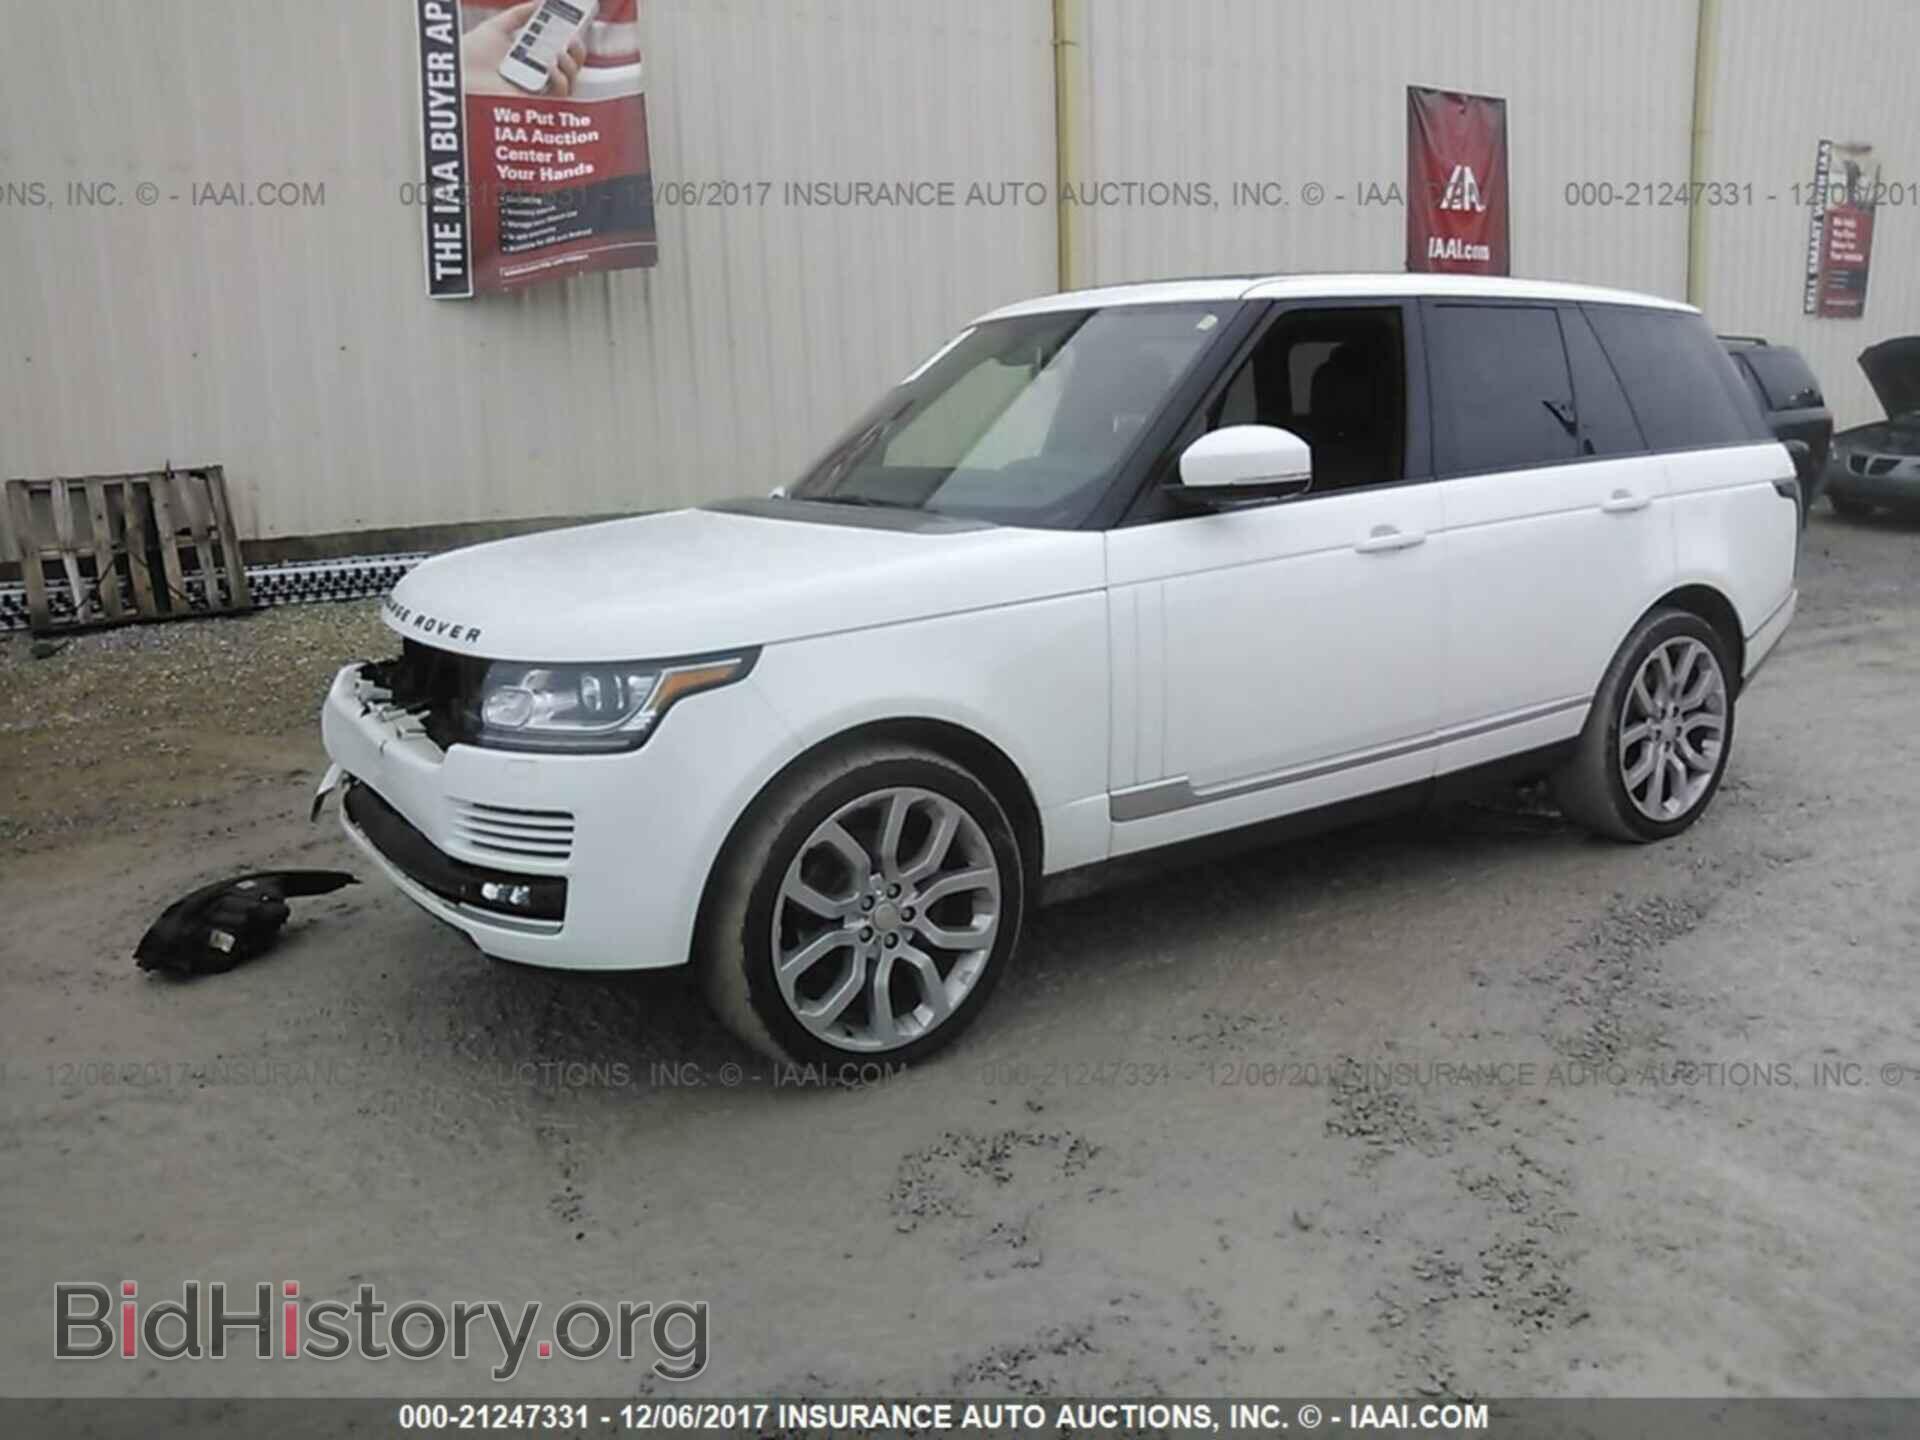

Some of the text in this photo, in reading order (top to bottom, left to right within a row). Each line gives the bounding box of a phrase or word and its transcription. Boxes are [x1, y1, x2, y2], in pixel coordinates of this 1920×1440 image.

[493, 107, 592, 128] We Put The
[425, 0, 463, 281] THE IAA BUYER AP
[495, 126, 600, 145] IAA Auction
[495, 145, 576, 163] Center In
[496, 162, 595, 181] Your Hands
[413, 614, 482, 643] ROVER
